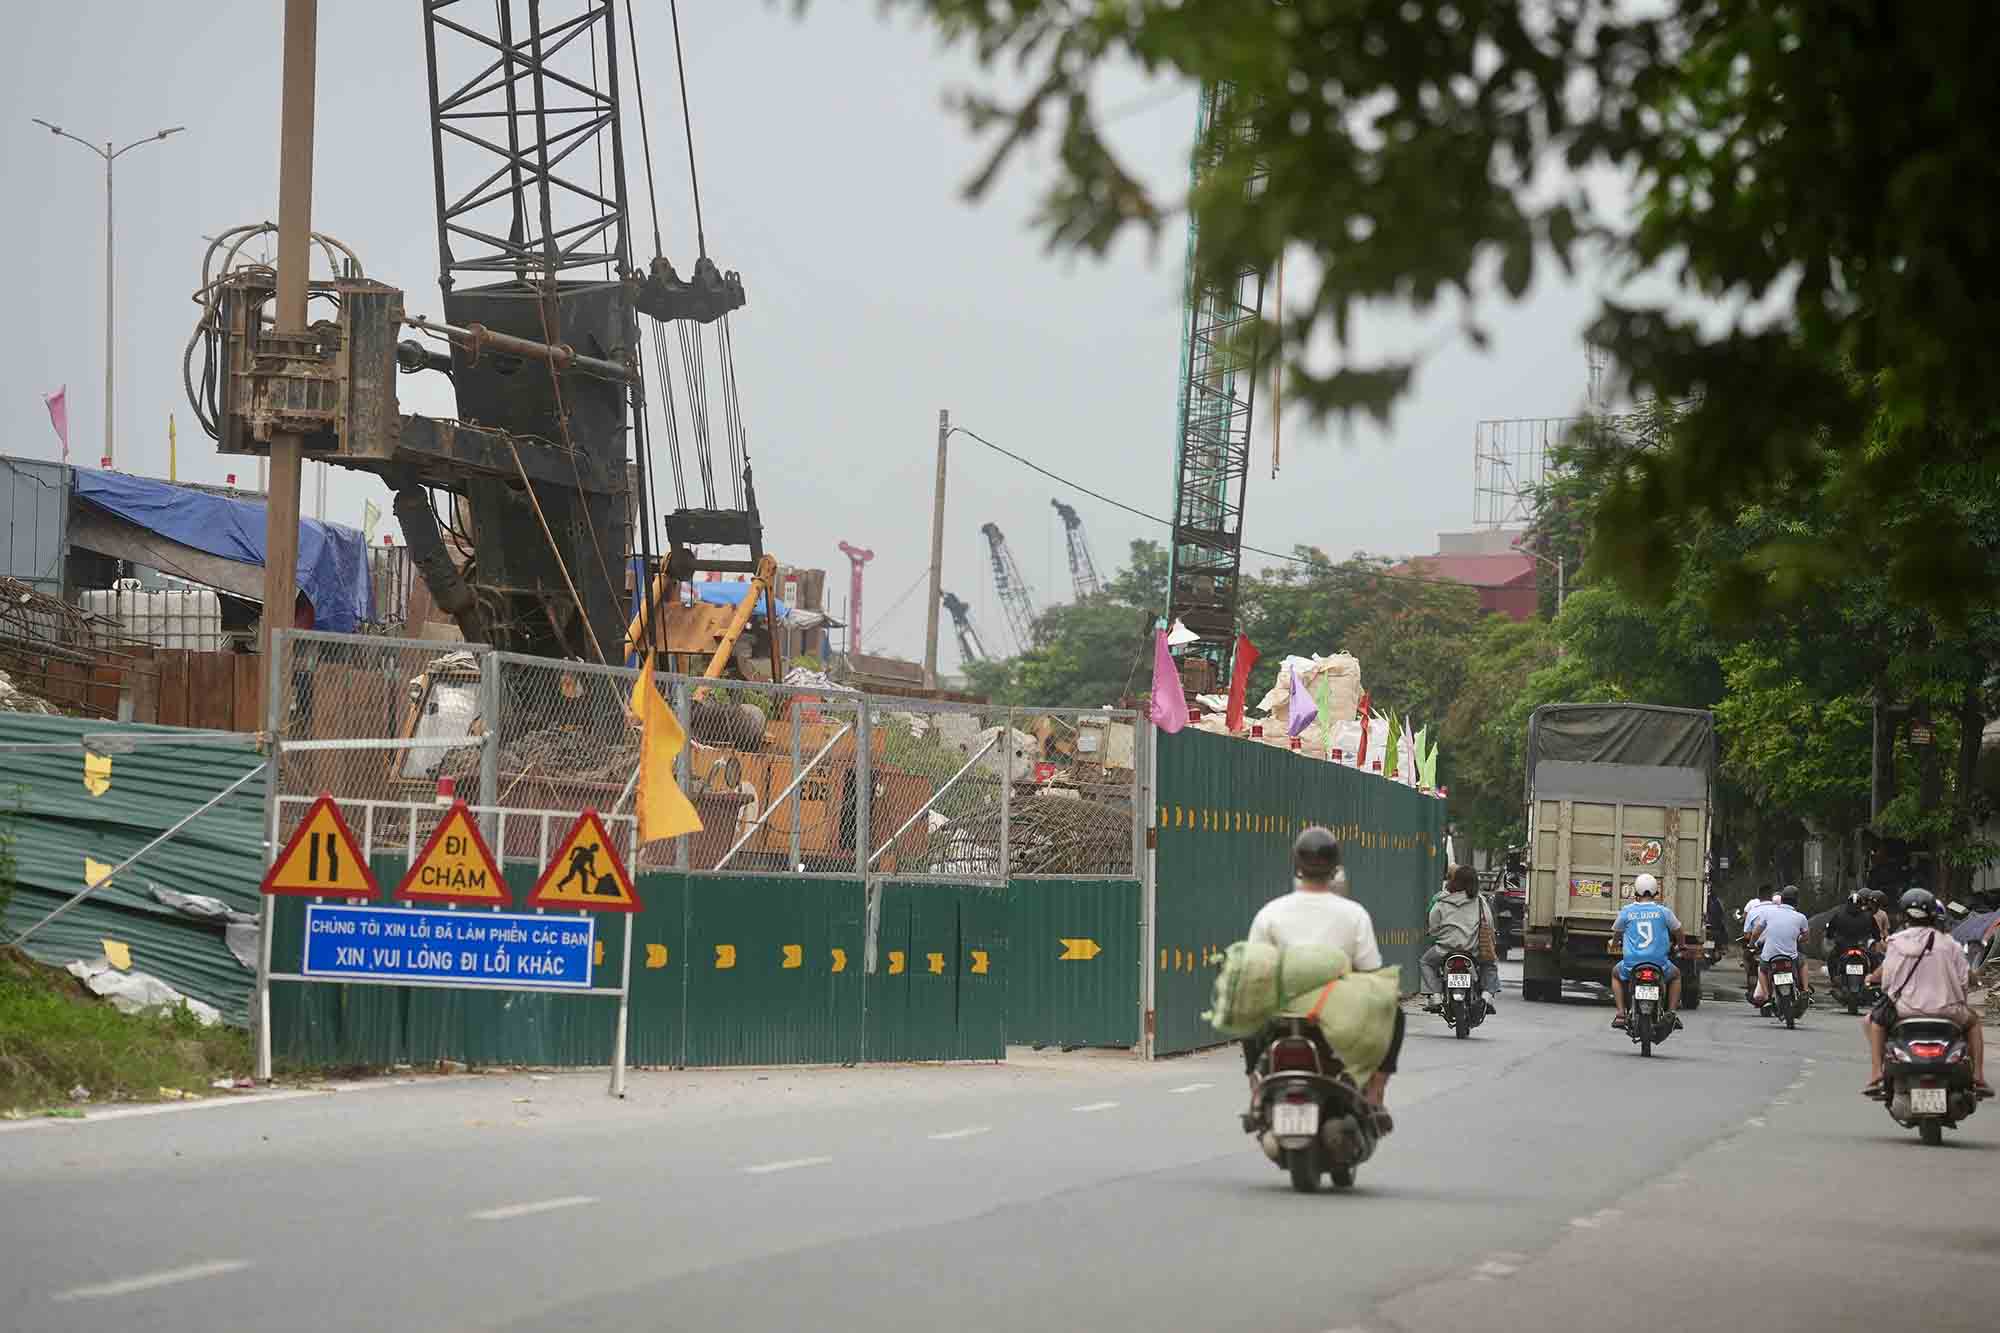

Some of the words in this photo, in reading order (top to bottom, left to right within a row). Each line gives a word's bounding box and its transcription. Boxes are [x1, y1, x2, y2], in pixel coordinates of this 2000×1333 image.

[446, 836, 467, 856] ĐI
[422, 862, 486, 891] CHẬM
[311, 916, 356, 935] CHÚNG
[360, 919, 381, 936] TÔI
[384, 923, 406, 937] XIN
[490, 920, 528, 943] PHIỀN
[532, 925, 558, 945] CÁC
[562, 931, 588, 949] BẠN
[335, 946, 364, 967] XIN
[372, 947, 401, 968] VUI
[407, 944, 453, 970] LÒNG
[460, 951, 477, 971] ĐI
[517, 949, 565, 976] KHÁC
